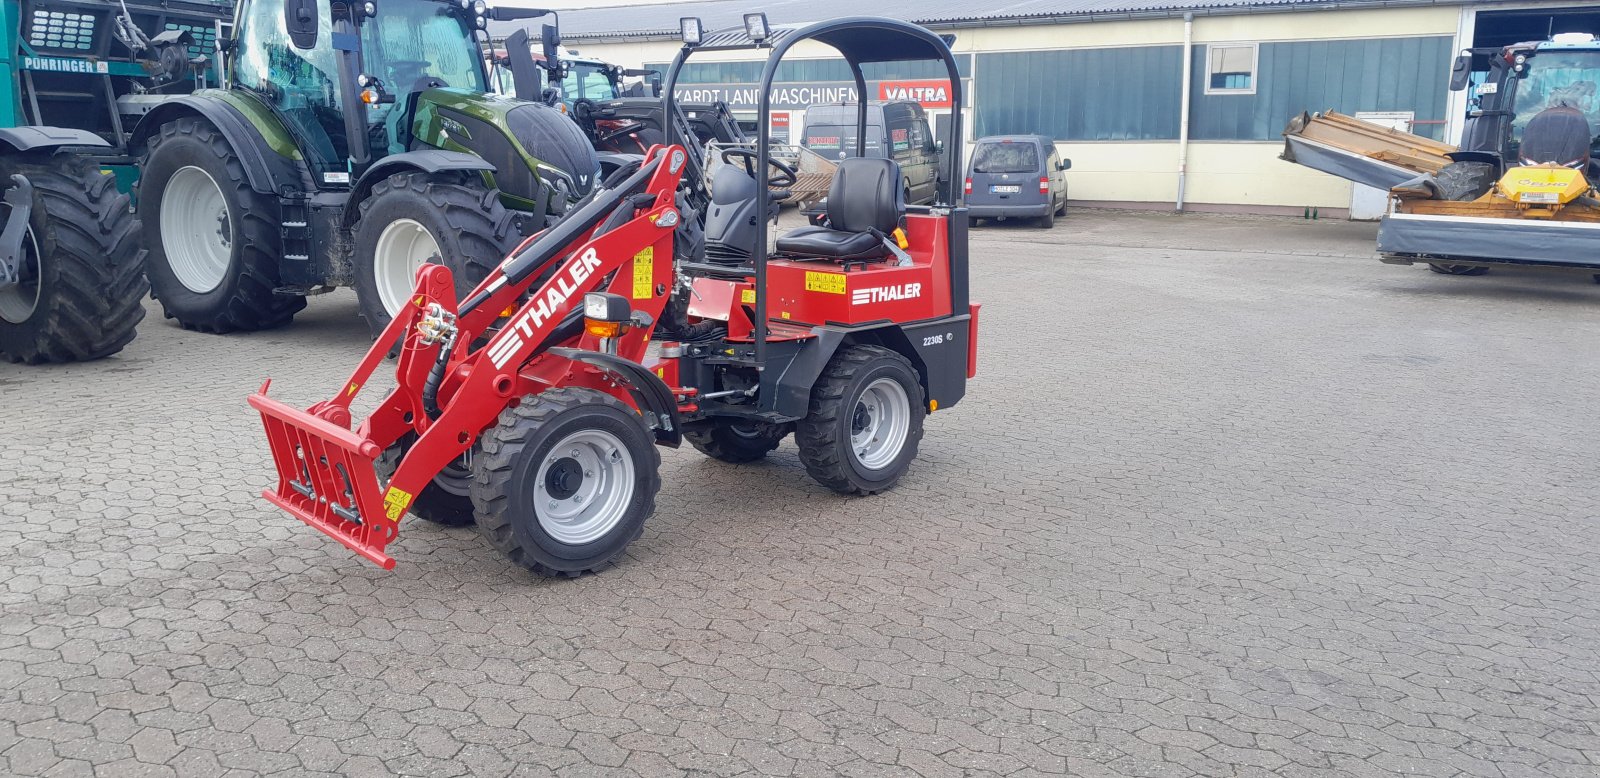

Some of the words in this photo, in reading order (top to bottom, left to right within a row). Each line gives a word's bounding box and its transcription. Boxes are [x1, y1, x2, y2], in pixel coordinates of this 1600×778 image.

[660, 89, 721, 103] KARDT
[885, 86, 948, 102] VALTRA
[514, 247, 602, 338] THALER
[870, 283, 921, 303] THALER
[923, 334, 943, 347] 2230S
